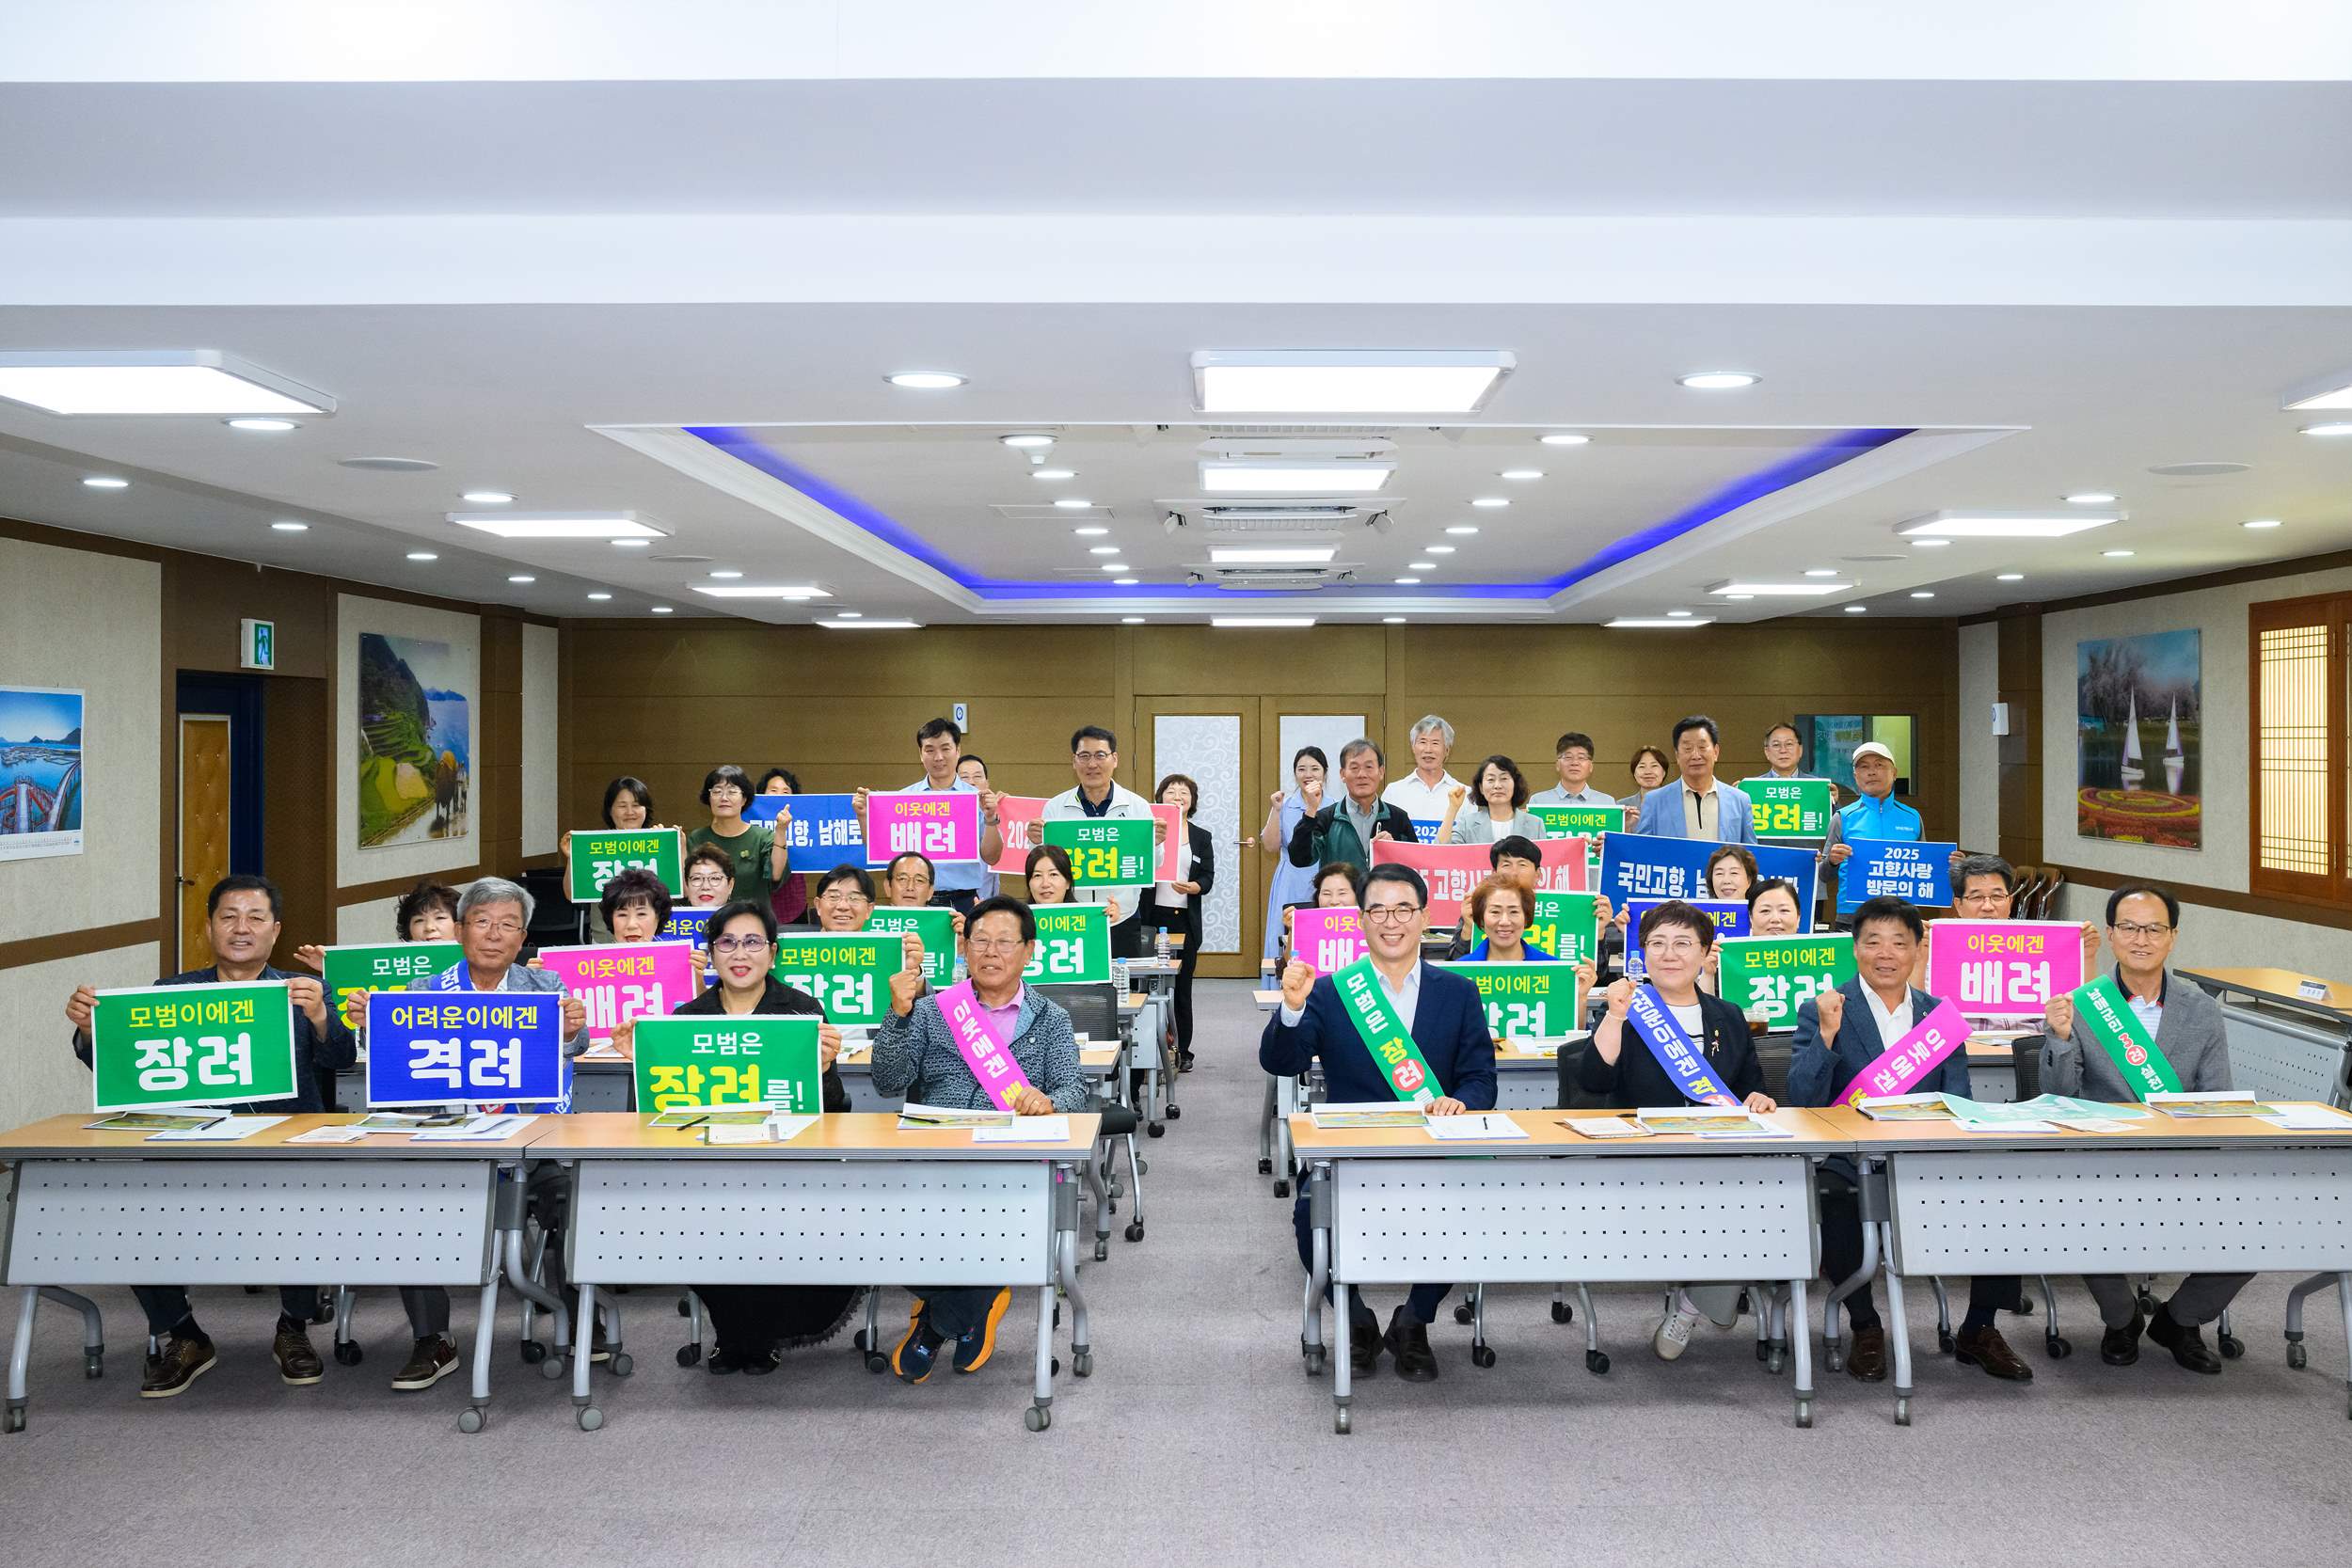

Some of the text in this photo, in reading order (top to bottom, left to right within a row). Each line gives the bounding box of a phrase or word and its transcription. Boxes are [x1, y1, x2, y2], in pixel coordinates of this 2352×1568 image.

[1765, 786, 1803, 800] 모범은
[895, 800, 951, 817] 이웃에겐
[1545, 814, 1607, 827] 모범이에겐
[1752, 803, 1823, 832] 장려를!
[818, 819, 863, 846] 남해로
[890, 821, 956, 853] 배려
[1008, 820, 1030, 849] 202
[1077, 827, 1120, 842] 모범은
[1414, 826, 1438, 837] 202
[589, 839, 660, 855] 모범이에겐
[1884, 847, 1919, 861] 2025
[1064, 847, 1144, 879] 장려를!
[1867, 860, 1933, 879] 고향사랑
[1434, 868, 1492, 901] 고향사
[1618, 862, 1689, 898] 국민고향,
[1867, 879, 1934, 899] 방문의 해
[1534, 901, 1561, 918] 범은
[869, 917, 919, 933] 모범은
[1035, 915, 1087, 933] 이에겐
[1325, 916, 1363, 932] 이웃
[1523, 924, 1585, 959] 려를!
[1967, 934, 2044, 955] 이웃에겐
[373, 956, 432, 976] 모범은
[578, 956, 656, 978] 이웃에겐
[780, 946, 877, 968] 모범이에겐
[1744, 947, 1836, 969] 모범이에겐
[784, 973, 873, 1016] 장려
[1475, 974, 1549, 994] 범이에겐
[1960, 960, 2050, 1005] 배려
[129, 998, 255, 1029] 모범이에겐
[573, 982, 664, 1028] 배려
[1346, 973, 1390, 1035] 모범은
[391, 1005, 538, 1030] 어려운이에겐
[691, 1032, 763, 1055] 모범은
[953, 999, 1009, 1079] 이웃에겐
[1632, 989, 1701, 1077] 려운이에겐
[134, 1031, 253, 1092] 장려
[408, 1037, 522, 1089] 격려
[1873, 1028, 1947, 1094] 이웃에겐
[649, 1064, 803, 1114] 장려를!
